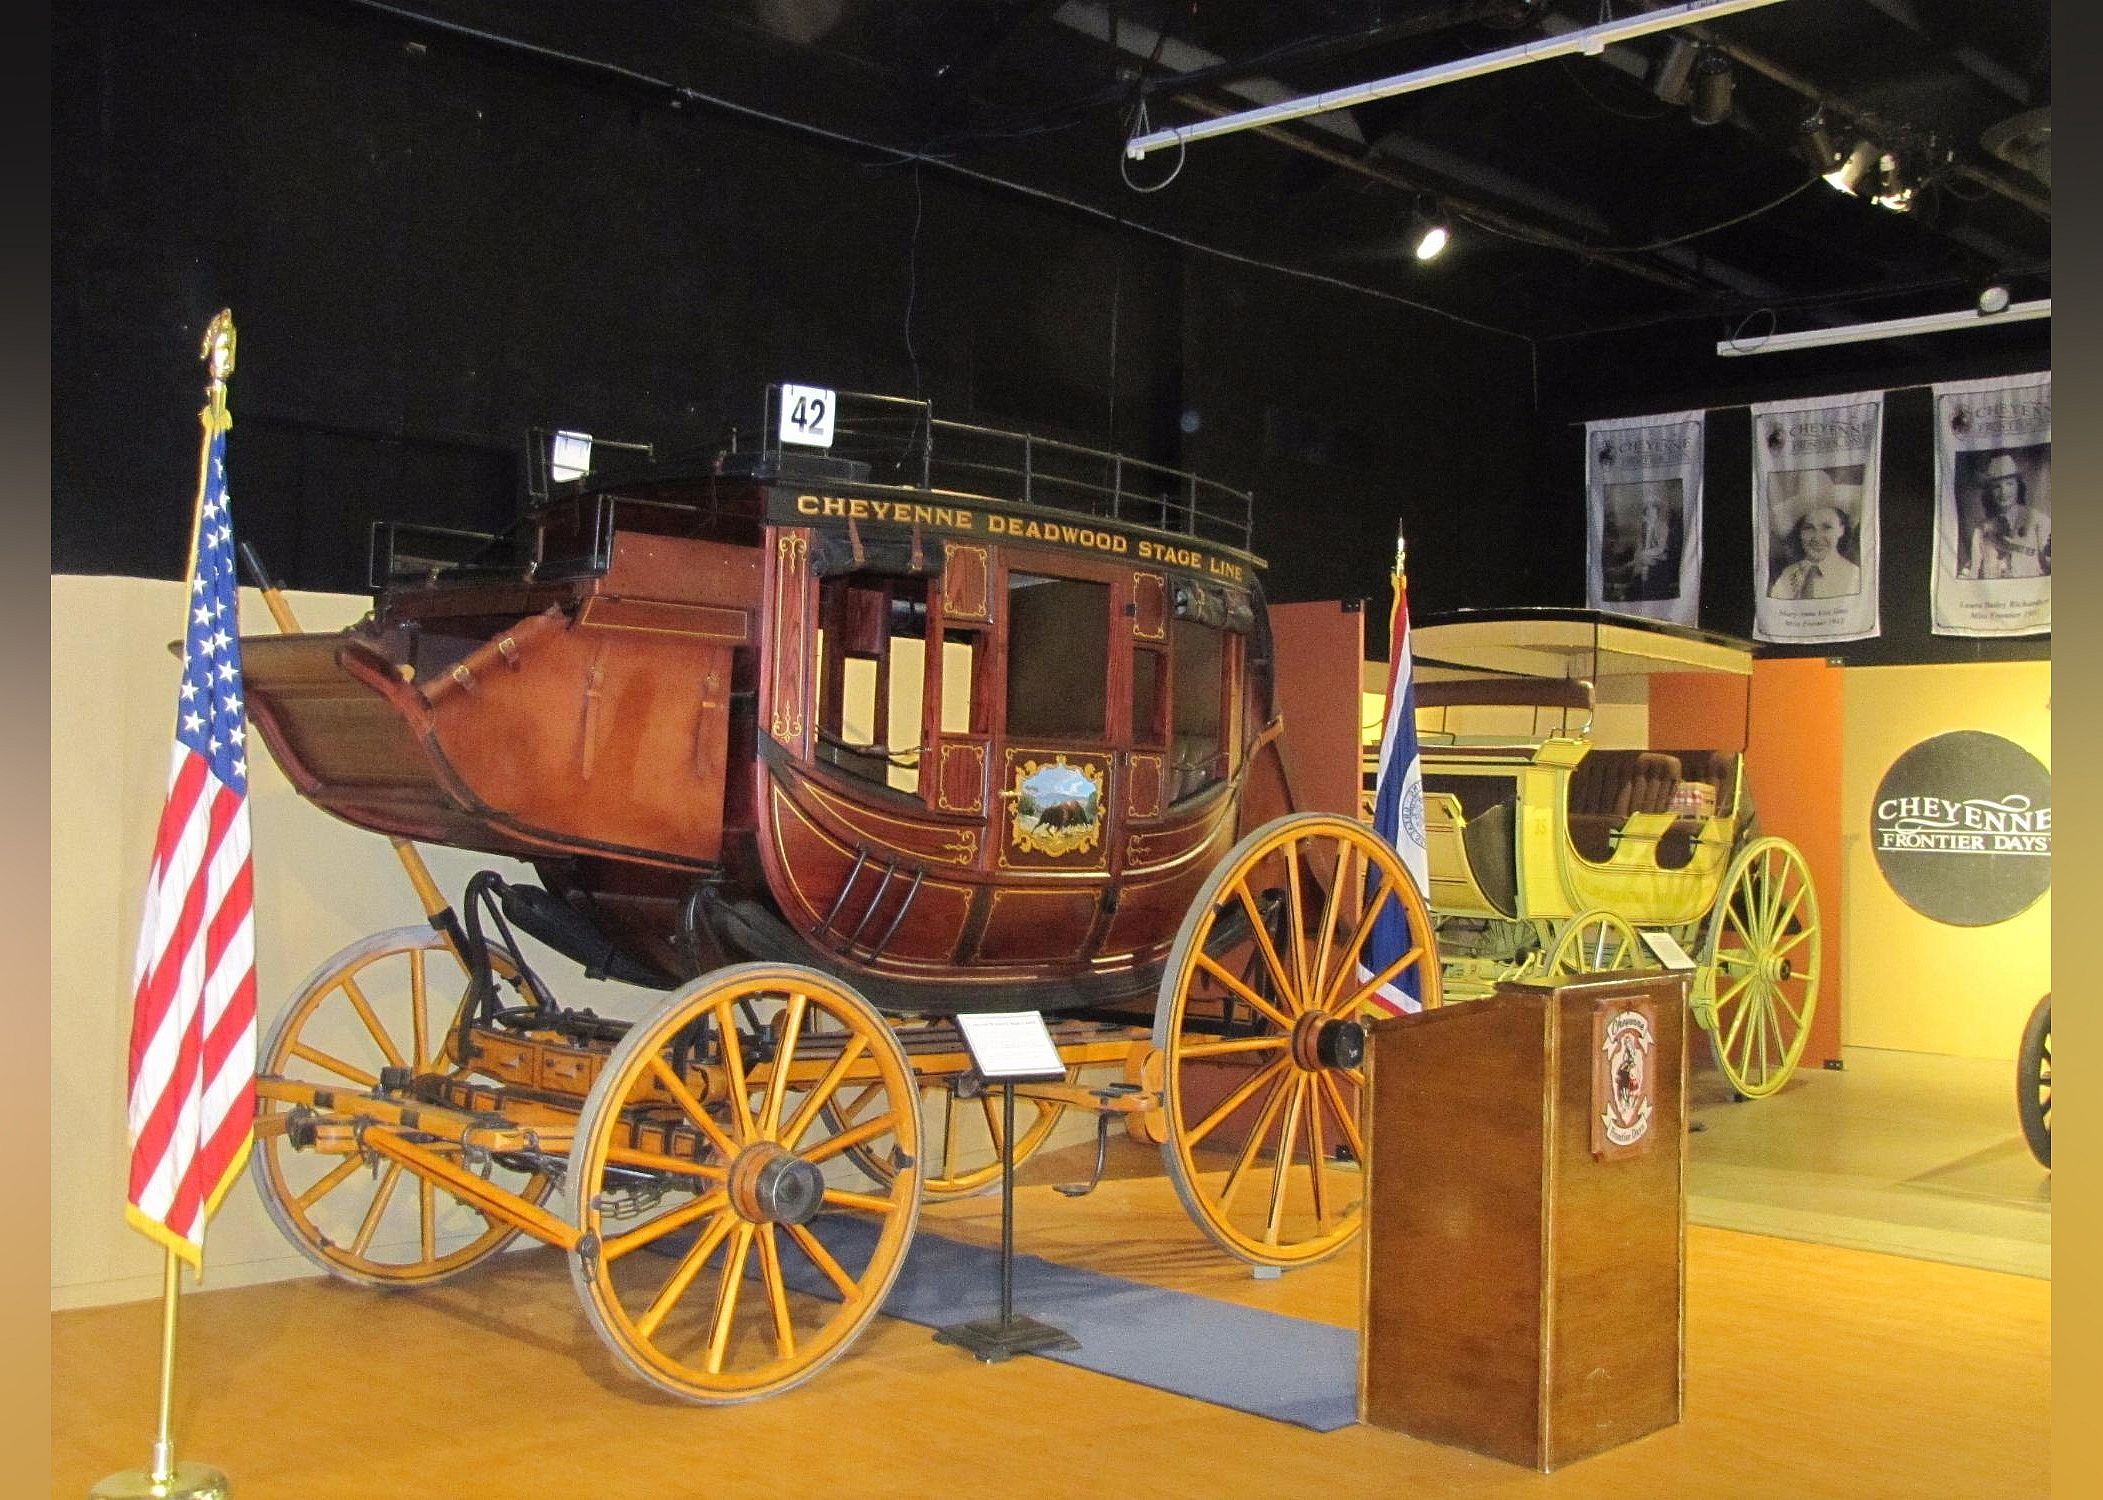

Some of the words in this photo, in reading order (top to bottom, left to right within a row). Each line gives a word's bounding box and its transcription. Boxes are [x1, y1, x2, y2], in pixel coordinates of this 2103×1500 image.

[790, 395, 825, 435] 42
[797, 494, 974, 529] CHEYENNE
[988, 514, 1128, 554] DEADWOOD
[1138, 540, 1202, 569] STAGE
[1210, 556, 1244, 584] LINE
[1878, 796, 2051, 833] CHEYENNE
[1882, 833, 1985, 850] FRONTIER
[1995, 835, 2048, 851] DAYS
[1611, 1013, 1645, 1034] Cheyenne
